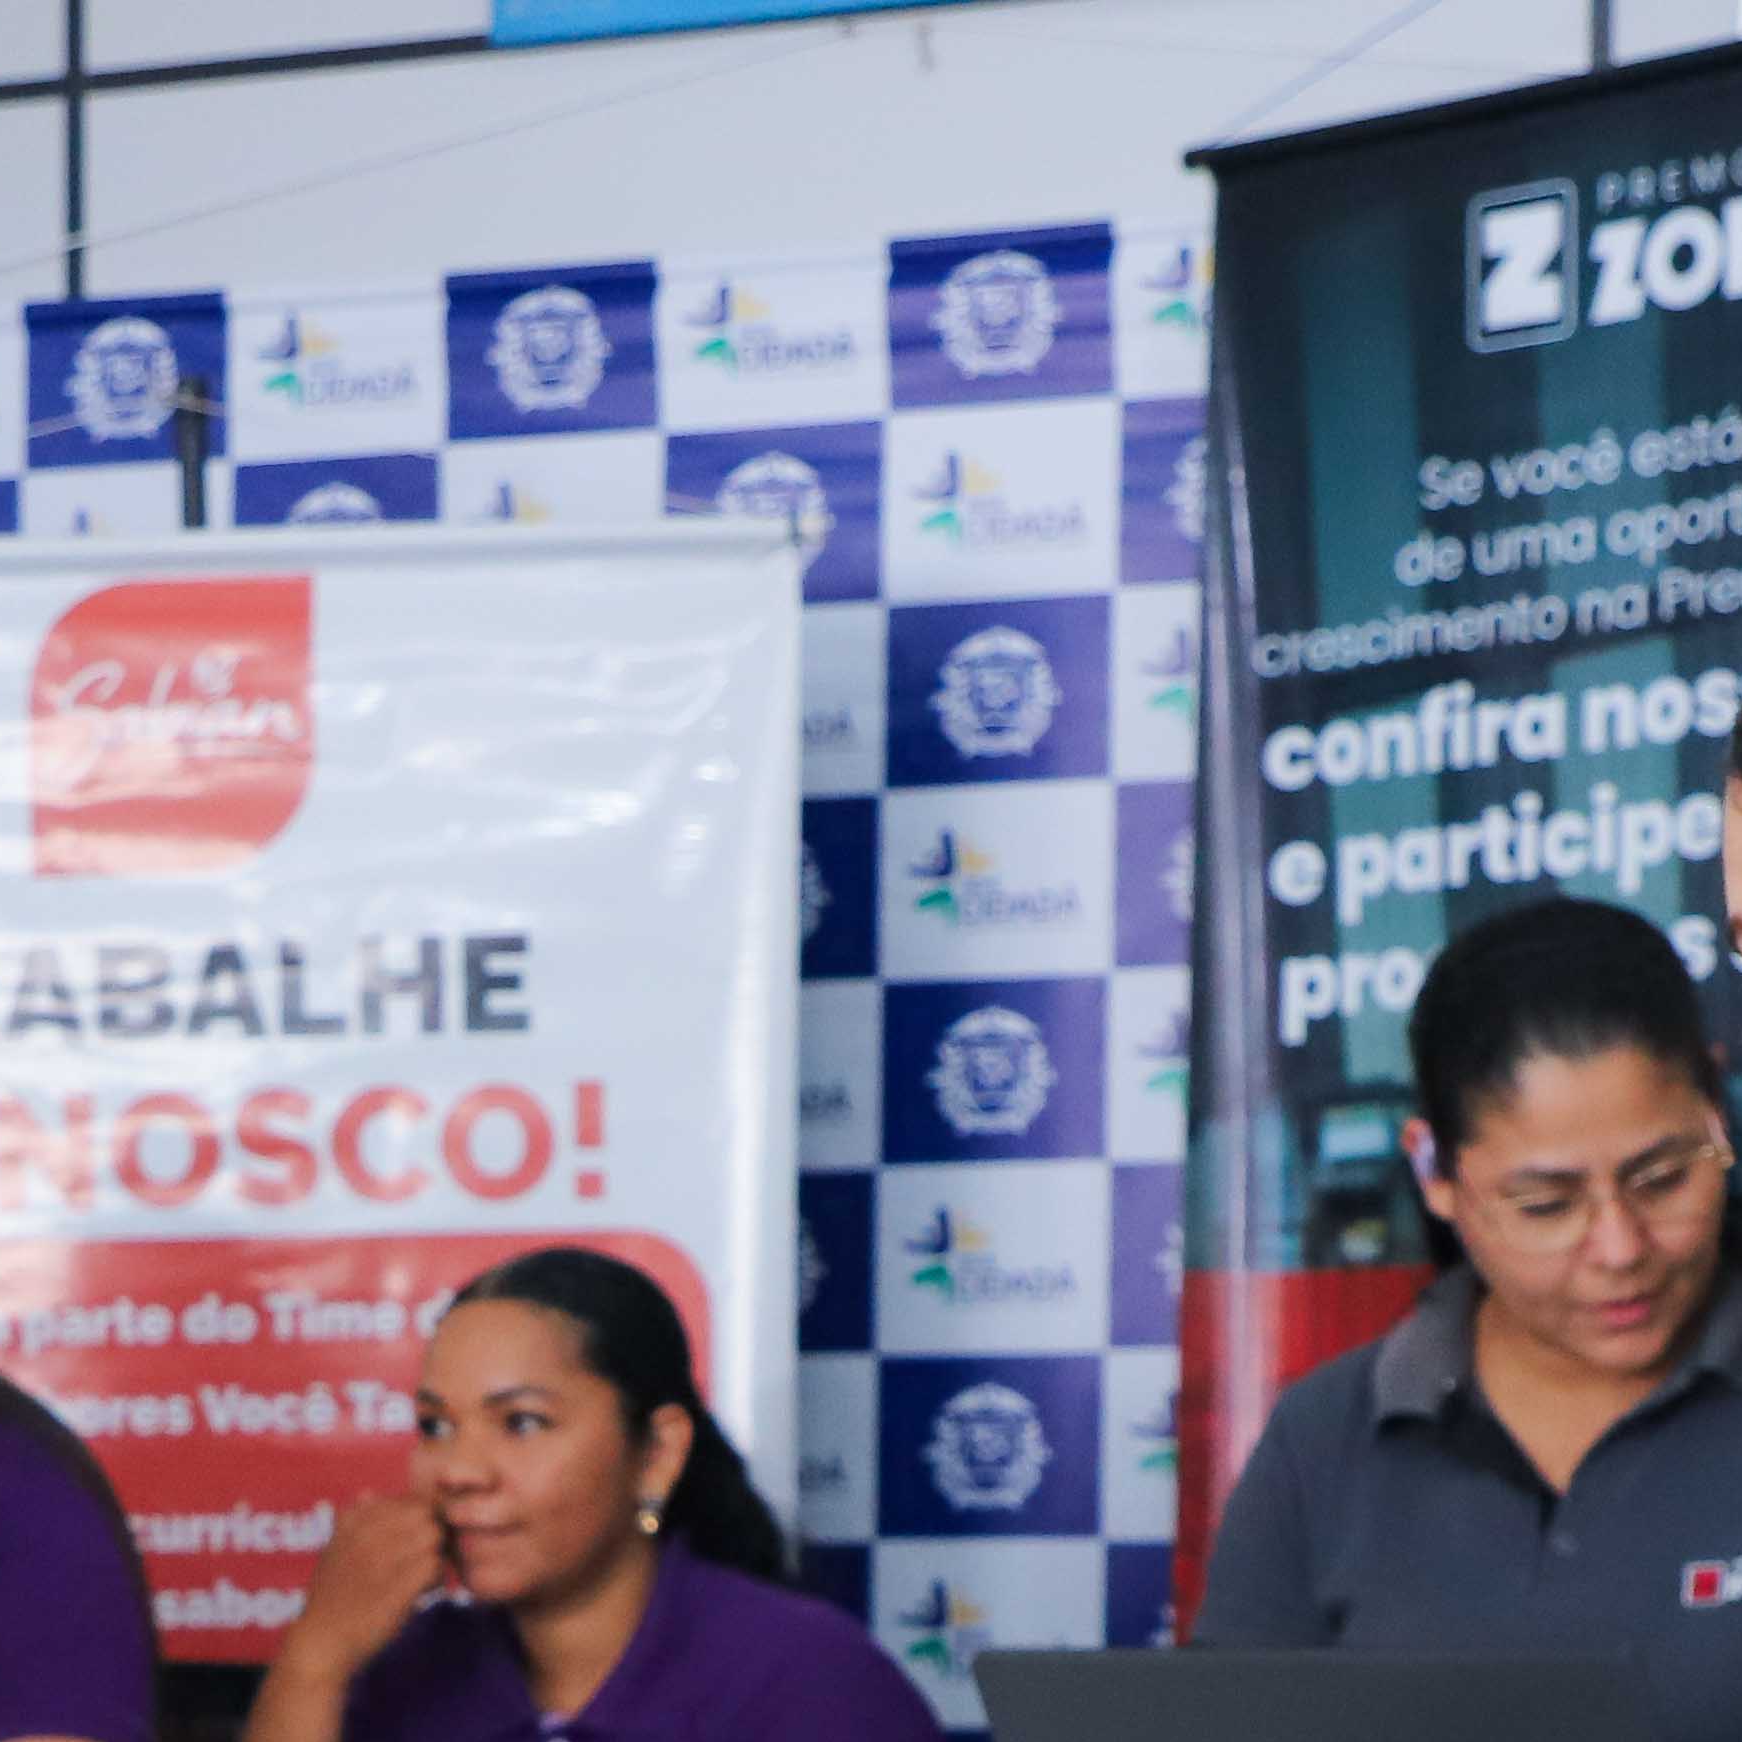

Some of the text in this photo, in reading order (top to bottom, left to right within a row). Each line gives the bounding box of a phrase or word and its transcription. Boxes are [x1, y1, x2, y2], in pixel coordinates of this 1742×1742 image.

[1418, 454, 1485, 511] Se
[1490, 425, 1623, 501] você
[1393, 528, 1466, 587] de
[1470, 514, 1598, 577] uma
[1252, 593, 1570, 678] crescimento
[1574, 582, 1651, 637] na
[1260, 676, 1568, 793] confira
[1266, 780, 1725, 928] e participe
[20, 1296, 175, 1360] parte
[179, 1291, 258, 1346] do
[263, 1287, 407, 1343] Time
[198, 1381, 339, 1437] Você
[341, 1380, 418, 1434] Ta
